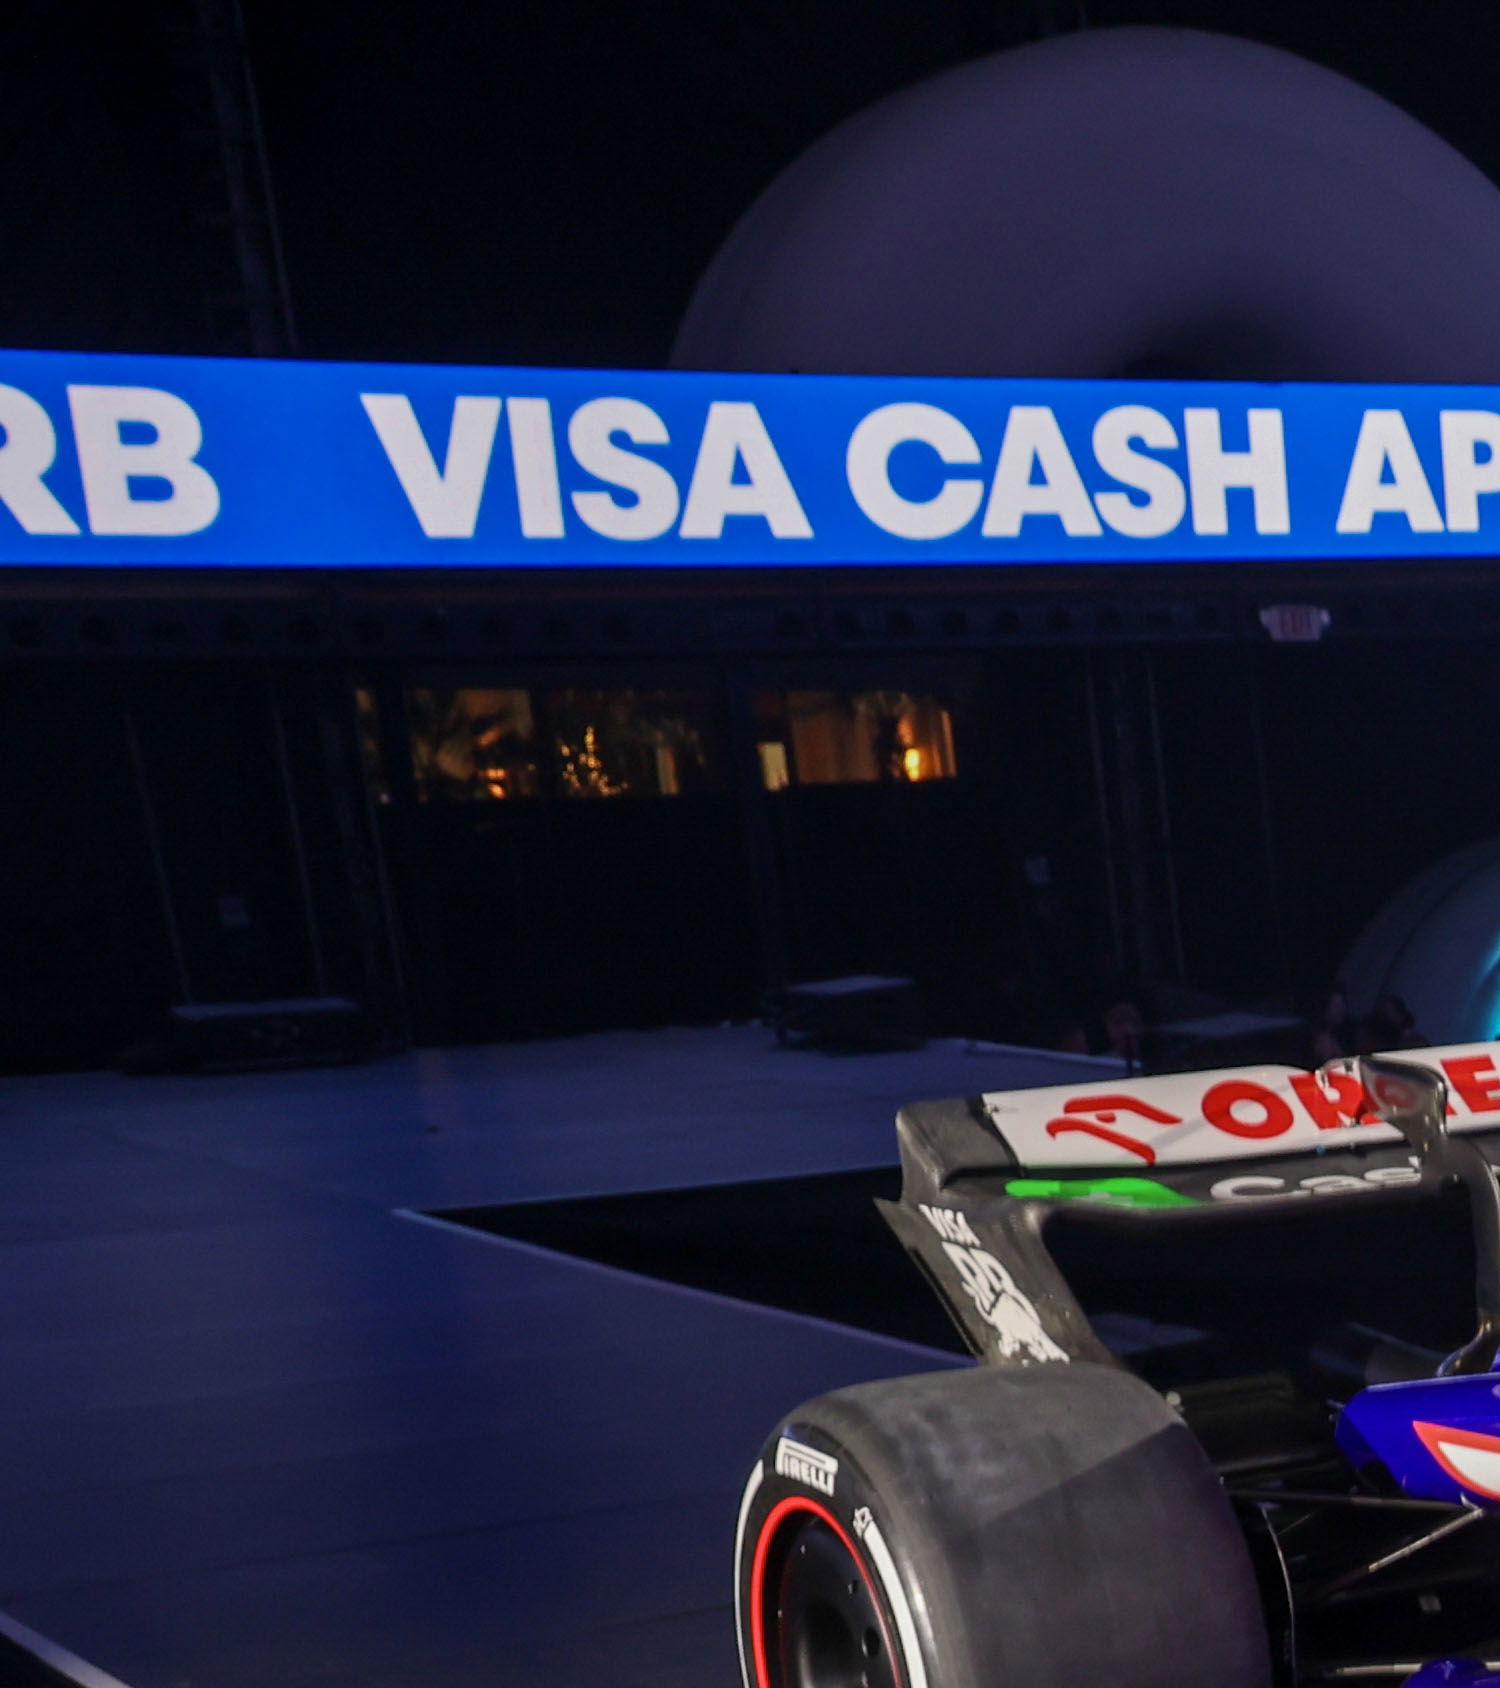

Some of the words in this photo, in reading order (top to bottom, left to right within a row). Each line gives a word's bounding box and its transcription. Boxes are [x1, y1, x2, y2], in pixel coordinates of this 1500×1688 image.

[360, 393, 814, 540] VISA
[846, 401, 1291, 539] CASH
[919, 1204, 981, 1248] VISA
[775, 1437, 838, 1497] PIRELLI
